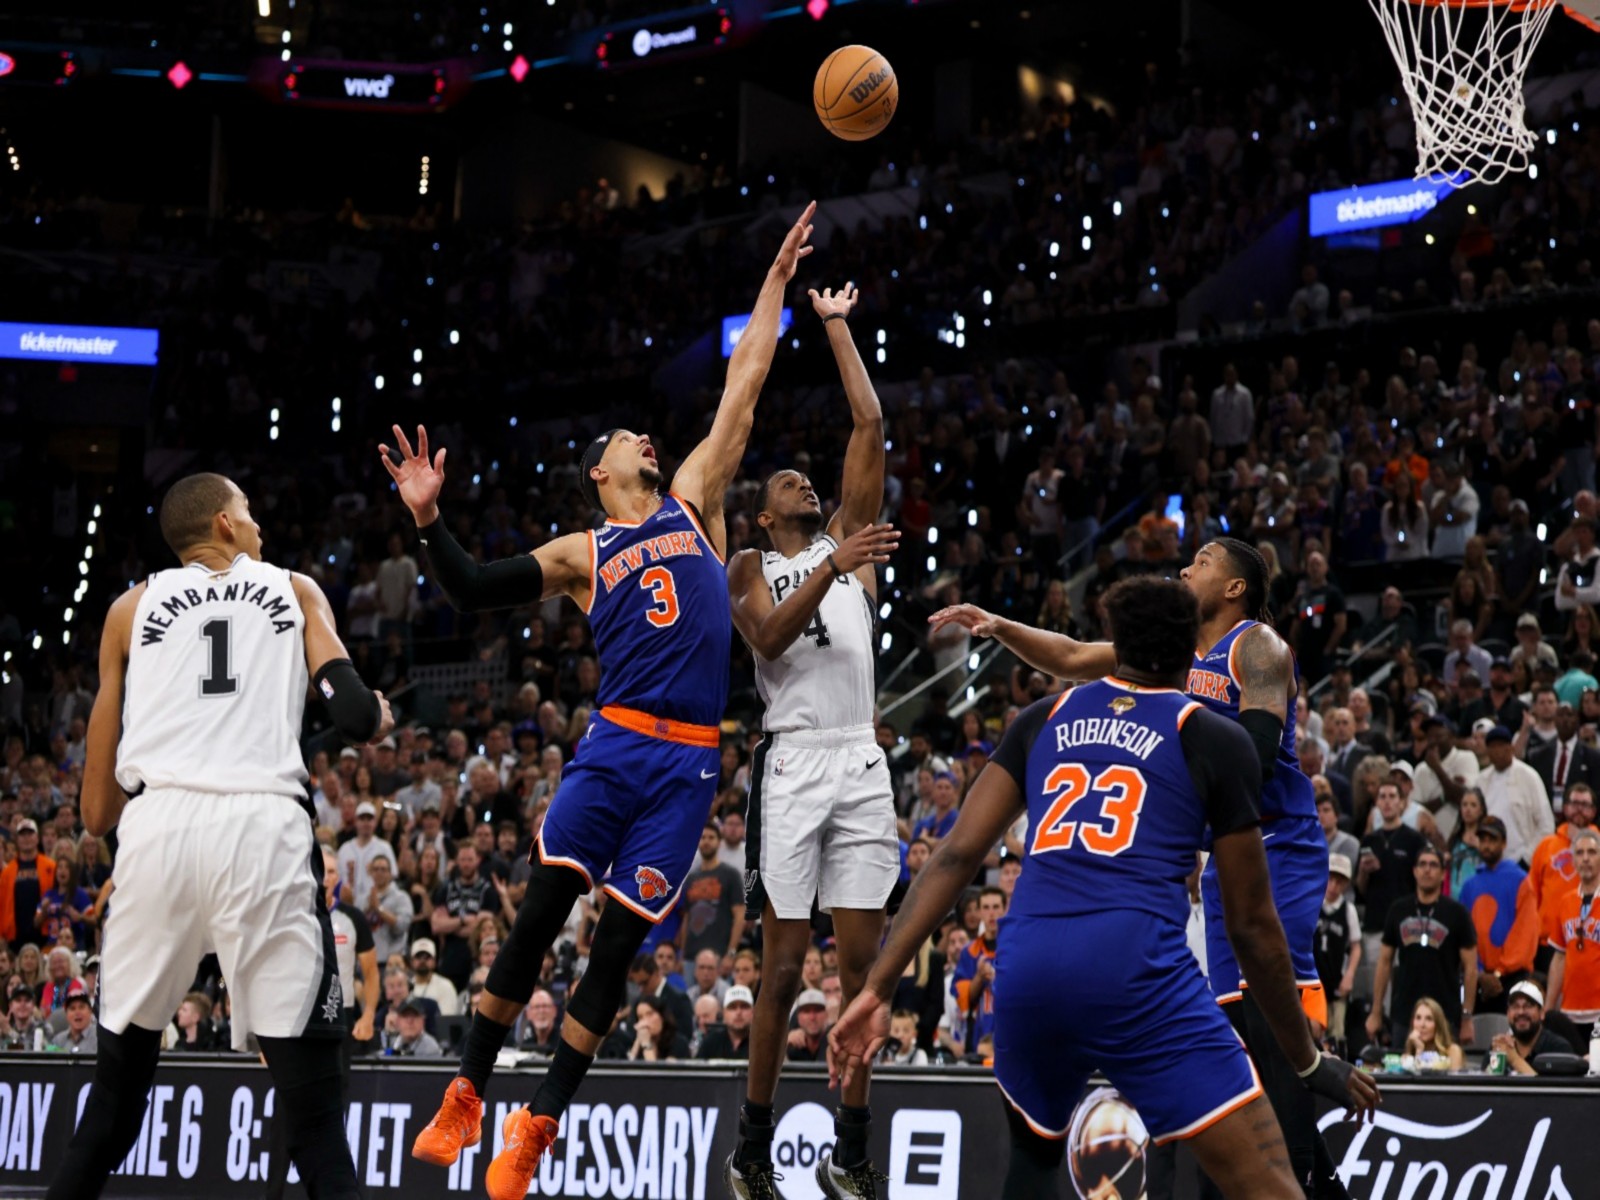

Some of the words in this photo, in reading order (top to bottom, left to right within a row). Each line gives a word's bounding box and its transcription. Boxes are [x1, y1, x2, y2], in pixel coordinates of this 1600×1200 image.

[848, 66, 889, 104] Wilso
[20, 331, 118, 355] ticketmaster
[599, 543, 643, 594] NEW
[641, 531, 703, 562] YORK
[141, 581, 295, 647] WEMBANYAMA
[640, 565, 680, 628] 3
[198, 615, 240, 699] 1
[801, 607, 832, 650] 4
[1184, 668, 1231, 704] YORK
[1055, 718, 1164, 760] ROBINSON
[1030, 763, 1147, 857] 23
[177, 1085, 203, 1179] 6
[491, 1102, 719, 1199] NCESSARY
[777, 1134, 833, 1176] abc
[1316, 1105, 1574, 1200] Finals
